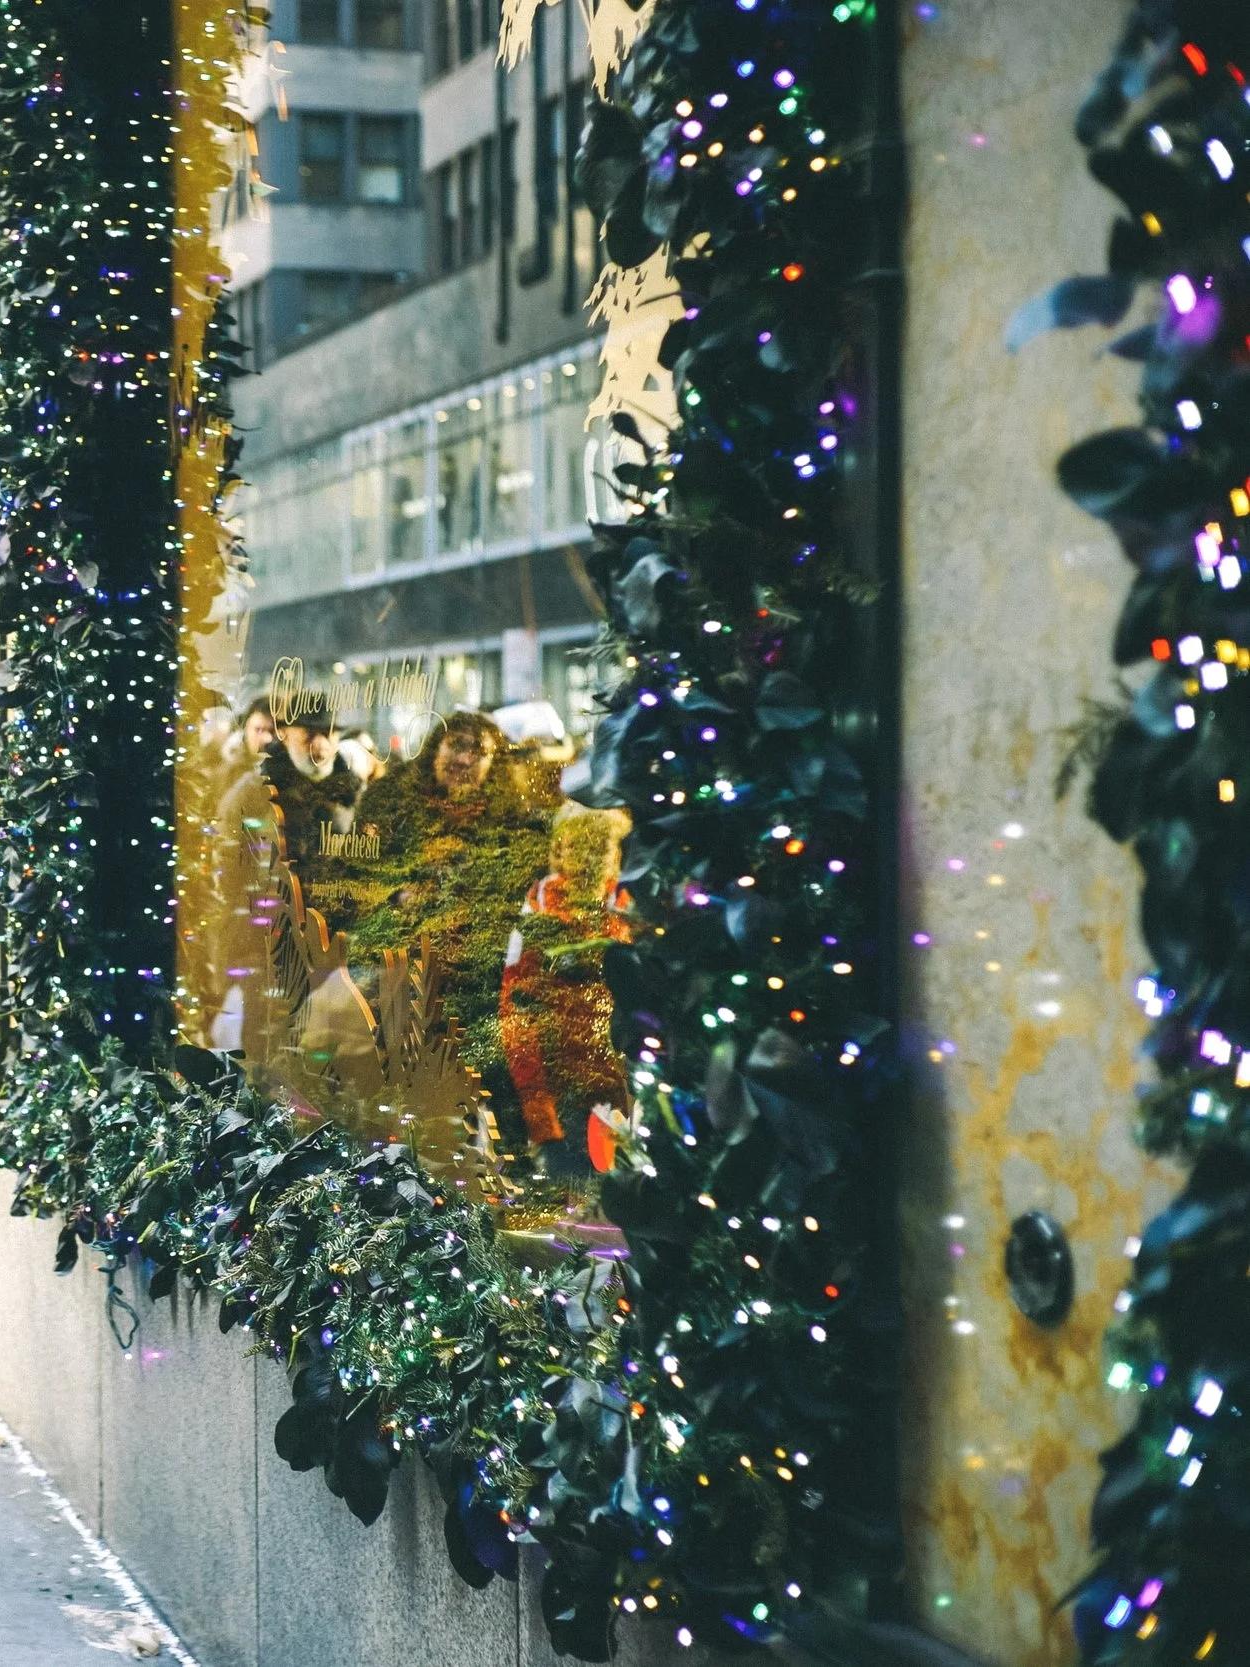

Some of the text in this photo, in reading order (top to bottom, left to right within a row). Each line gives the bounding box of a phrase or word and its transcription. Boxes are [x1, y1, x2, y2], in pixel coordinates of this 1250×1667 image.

[270, 653, 448, 761] Once upon a holiday
[318, 820, 381, 859] Marchesa
